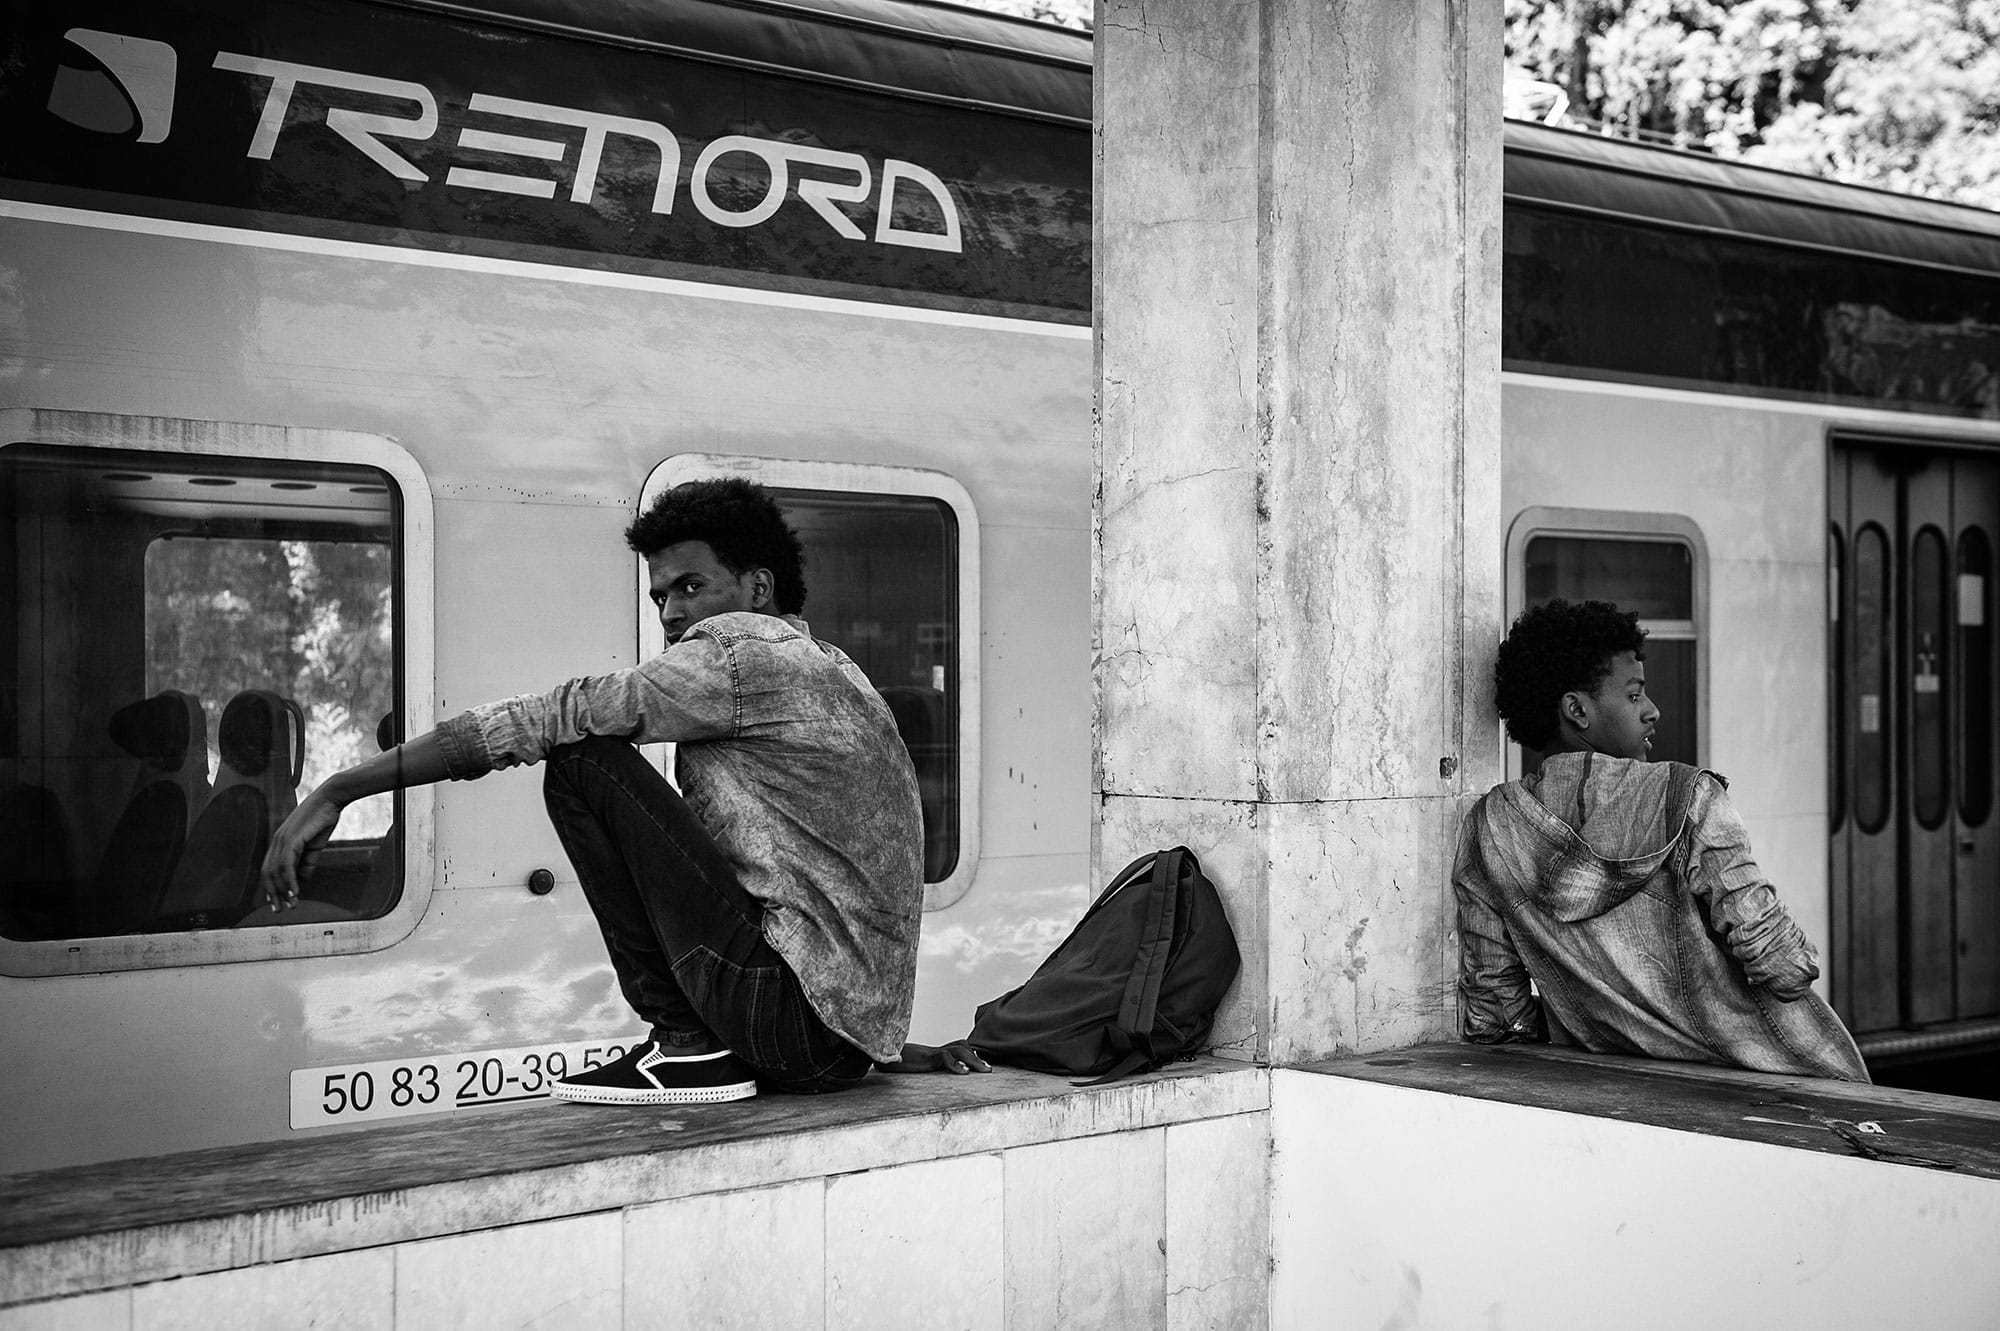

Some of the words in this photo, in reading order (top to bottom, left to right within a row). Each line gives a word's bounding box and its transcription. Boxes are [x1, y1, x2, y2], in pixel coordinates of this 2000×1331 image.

[212, 51, 962, 254] TRENORD
[322, 1071, 374, 1115] 50
[390, 1064, 440, 1107] 83
[455, 1052, 567, 1100] 20-39
